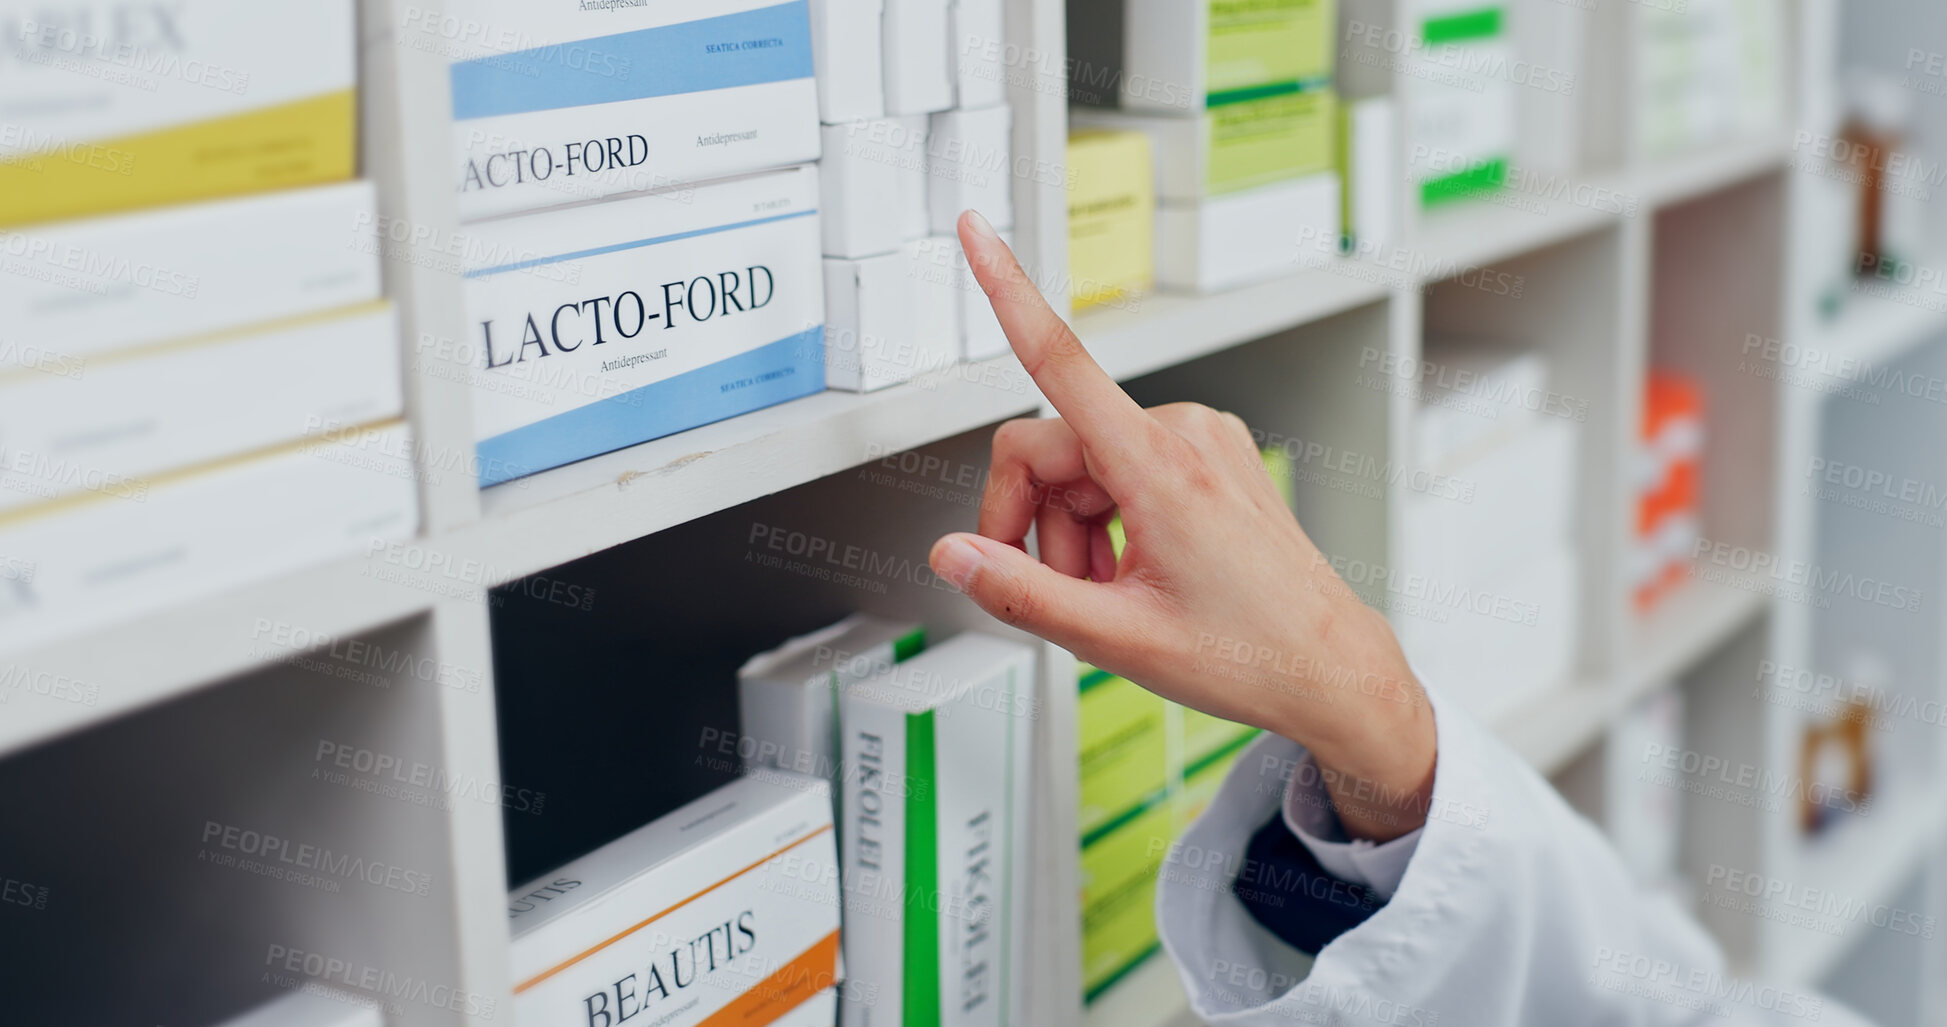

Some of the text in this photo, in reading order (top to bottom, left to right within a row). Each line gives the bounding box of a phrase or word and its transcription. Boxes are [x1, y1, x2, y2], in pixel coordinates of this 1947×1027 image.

[705, 38, 784, 54] SEATICA CORRECTA
[696, 129, 758, 148] Antidepressant
[455, 134, 649, 193] ACTO-FORD
[480, 264, 775, 370] LACTO-FORD
[600, 347, 668, 373] Antidepressant
[583, 910, 757, 1027] BEAUTIS
